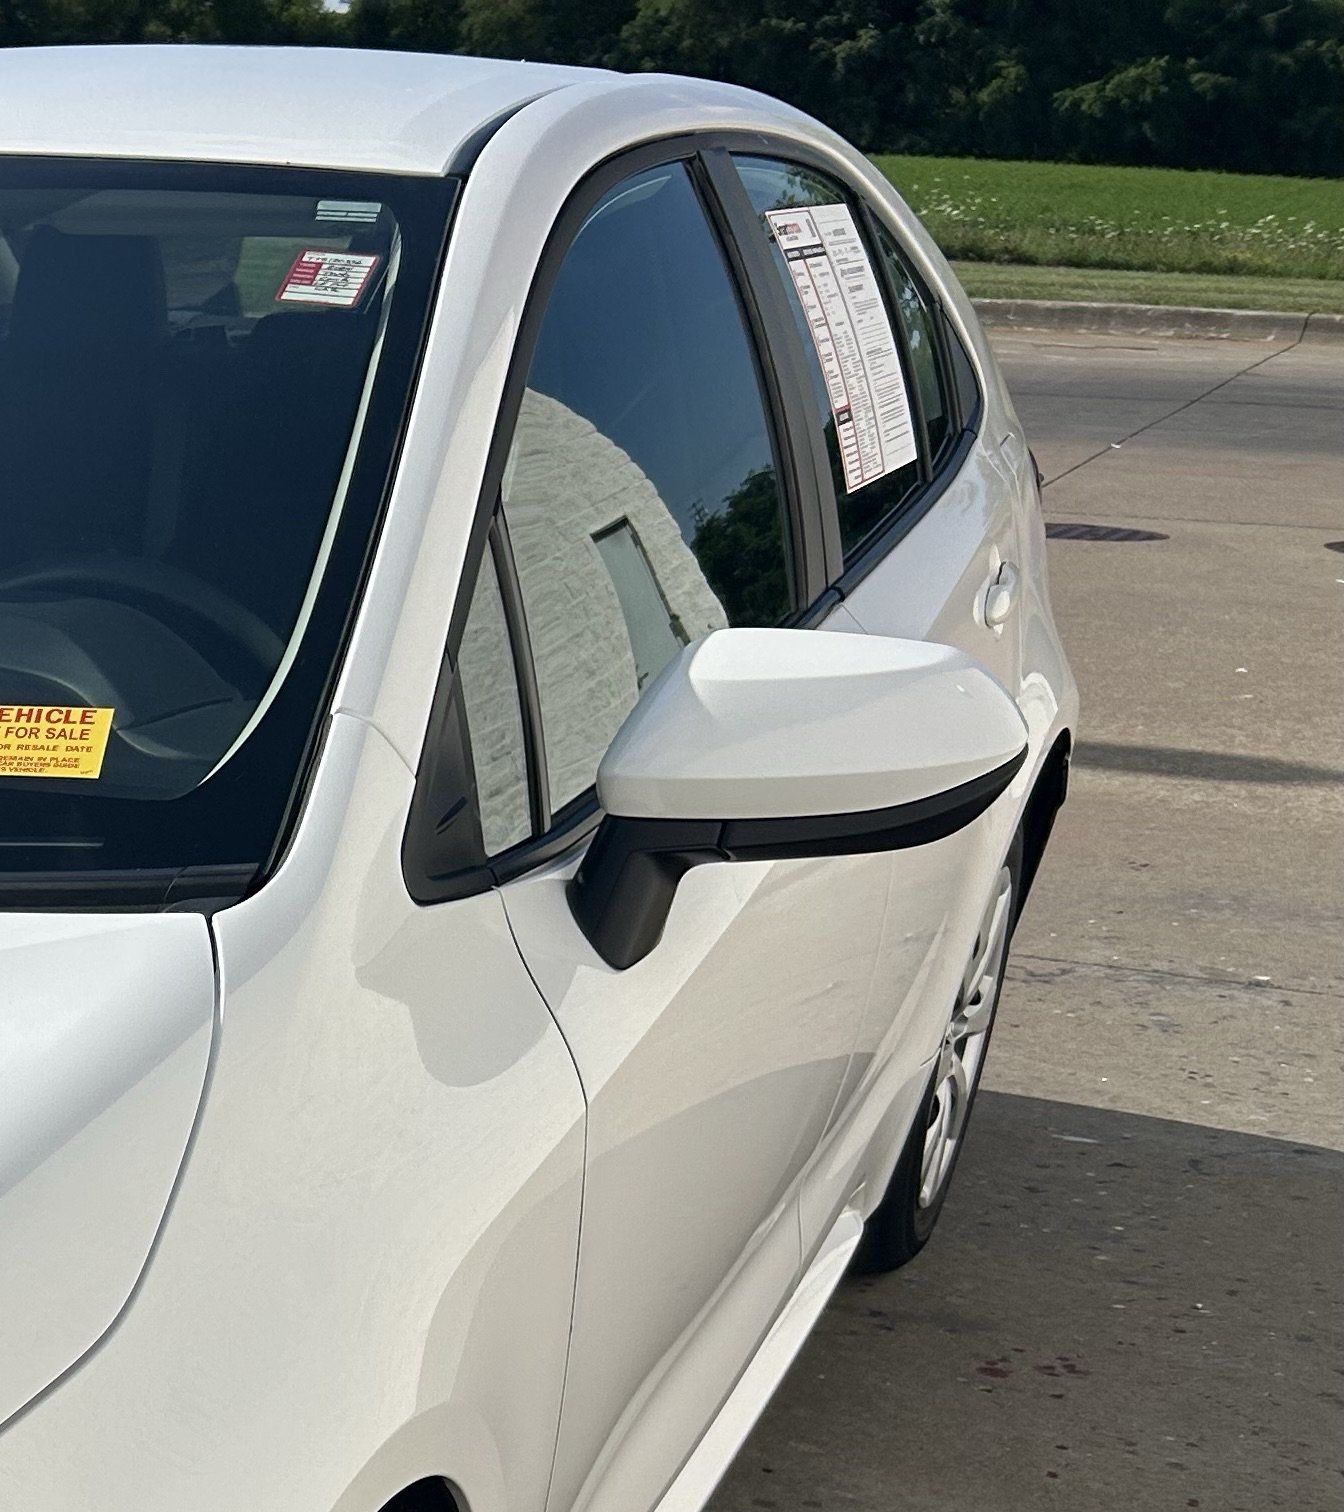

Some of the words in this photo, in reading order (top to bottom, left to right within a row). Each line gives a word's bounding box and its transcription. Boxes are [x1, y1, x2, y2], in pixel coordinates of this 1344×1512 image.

[4, 726, 41, 740] FOR
[44, 727, 91, 741] SALE
[16, 744, 59, 752] RESALE
[65, 745, 93, 753] DATE
